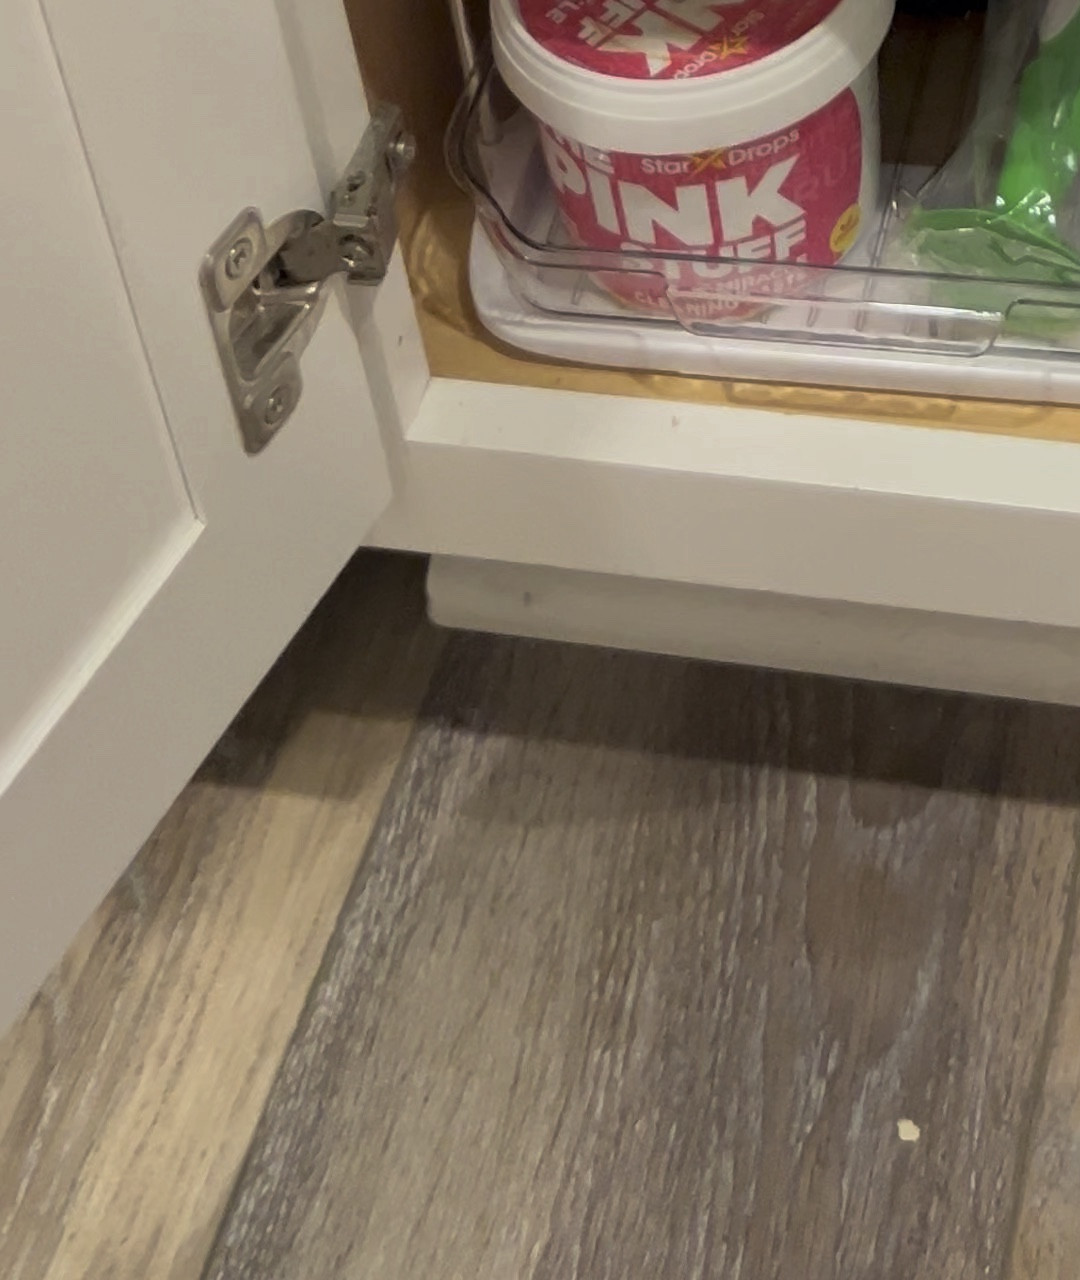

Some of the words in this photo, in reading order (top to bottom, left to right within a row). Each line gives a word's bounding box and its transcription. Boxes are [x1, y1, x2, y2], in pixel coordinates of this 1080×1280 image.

[540, 122, 807, 247] PINK
[641, 156, 691, 176] Star
[727, 128, 802, 168] Drops
